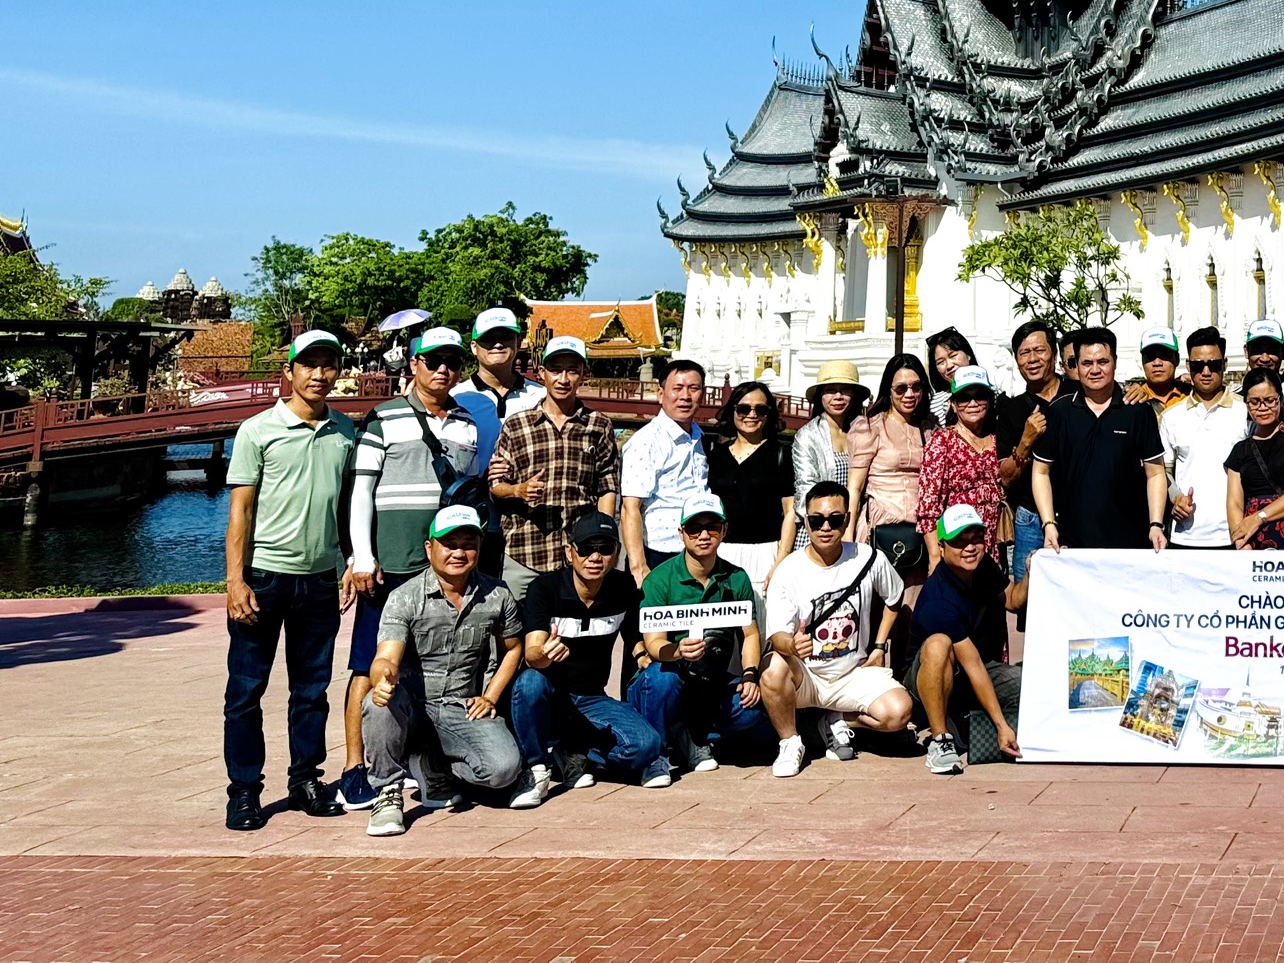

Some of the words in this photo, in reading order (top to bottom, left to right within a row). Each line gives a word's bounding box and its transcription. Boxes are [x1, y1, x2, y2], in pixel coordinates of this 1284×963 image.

[644, 610, 673, 621] HOA
[676, 608, 709, 618] BINH
[712, 606, 747, 616] MINH
[1121, 609, 1170, 628] CÔNG
[1173, 614, 1194, 629] TY
[1197, 610, 1222, 629] CỔ
[1226, 610, 1271, 630] PHẦN
[643, 621, 676, 629] CERAMIC
